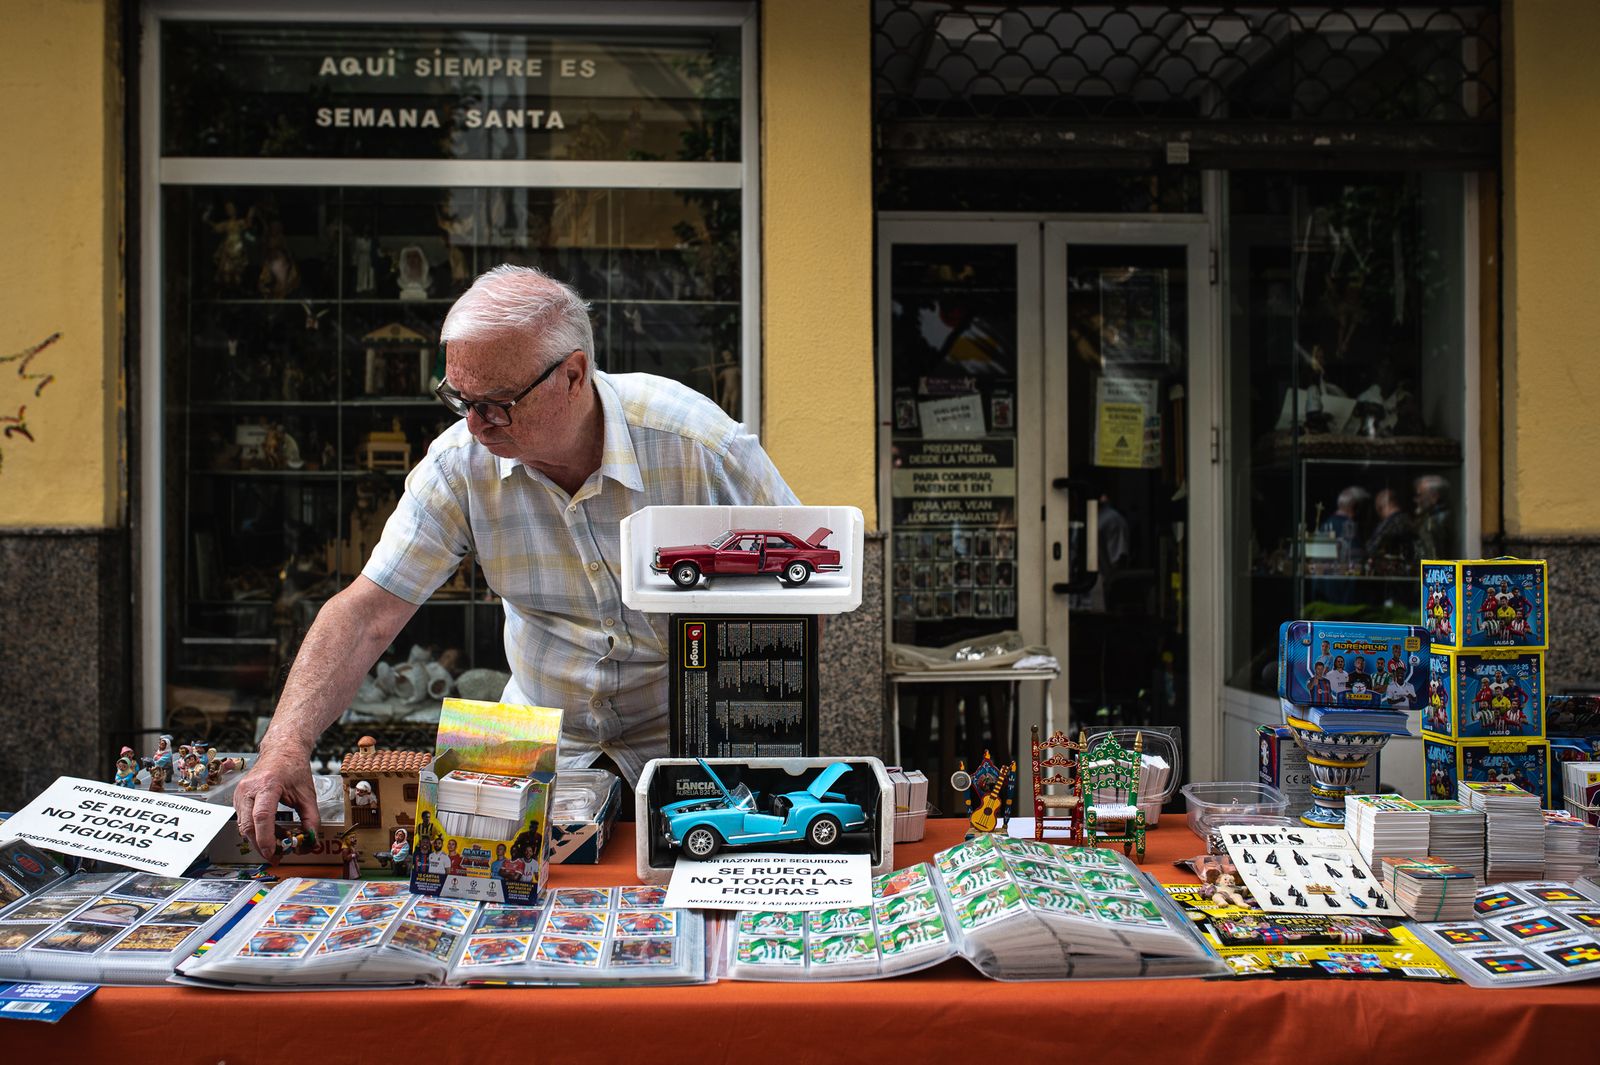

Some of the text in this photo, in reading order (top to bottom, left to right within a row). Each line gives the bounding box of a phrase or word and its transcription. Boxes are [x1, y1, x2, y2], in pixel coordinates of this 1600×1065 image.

[560, 59, 596, 77] ES
[316, 108, 564, 129] SEMANA SANTA
[923, 444, 982, 453] PREGUNTAR
[909, 455, 997, 464] DESDE LA PUERTA
[913, 473, 939, 481] PARA
[948, 483, 960, 492] DE
[971, 484, 984, 492] EN
[912, 501, 940, 510] PARA
[965, 501, 992, 510] VEAN
[908, 512, 998, 522] LOS ESCAPARATES
[688, 627, 702, 666] burago
[1333, 642, 1388, 651] ADRENALYN
[676, 781, 715, 790] LANCIA
[73, 785, 93, 793] POR
[94, 788, 140, 801] RAZONES
[156, 801, 212, 816] SEGURIDAD
[78, 800, 180, 827] SE RUEGA
[41, 807, 195, 843] NO TOCAR LAS
[59, 823, 153, 849] FIGURAS
[1229, 833, 1304, 846] PIN'S
[15, 832, 70, 847] NOSOTROS
[84, 845, 104, 854] LAS
[105, 850, 170, 868] MOSTRAMOS
[718, 867, 828, 876] SE RUEGA
[730, 877, 804, 886] TOCAR
[811, 878, 853, 886] LAS
[721, 887, 820, 896] FIGURAS
[1275, 918, 1325, 926] ORO
